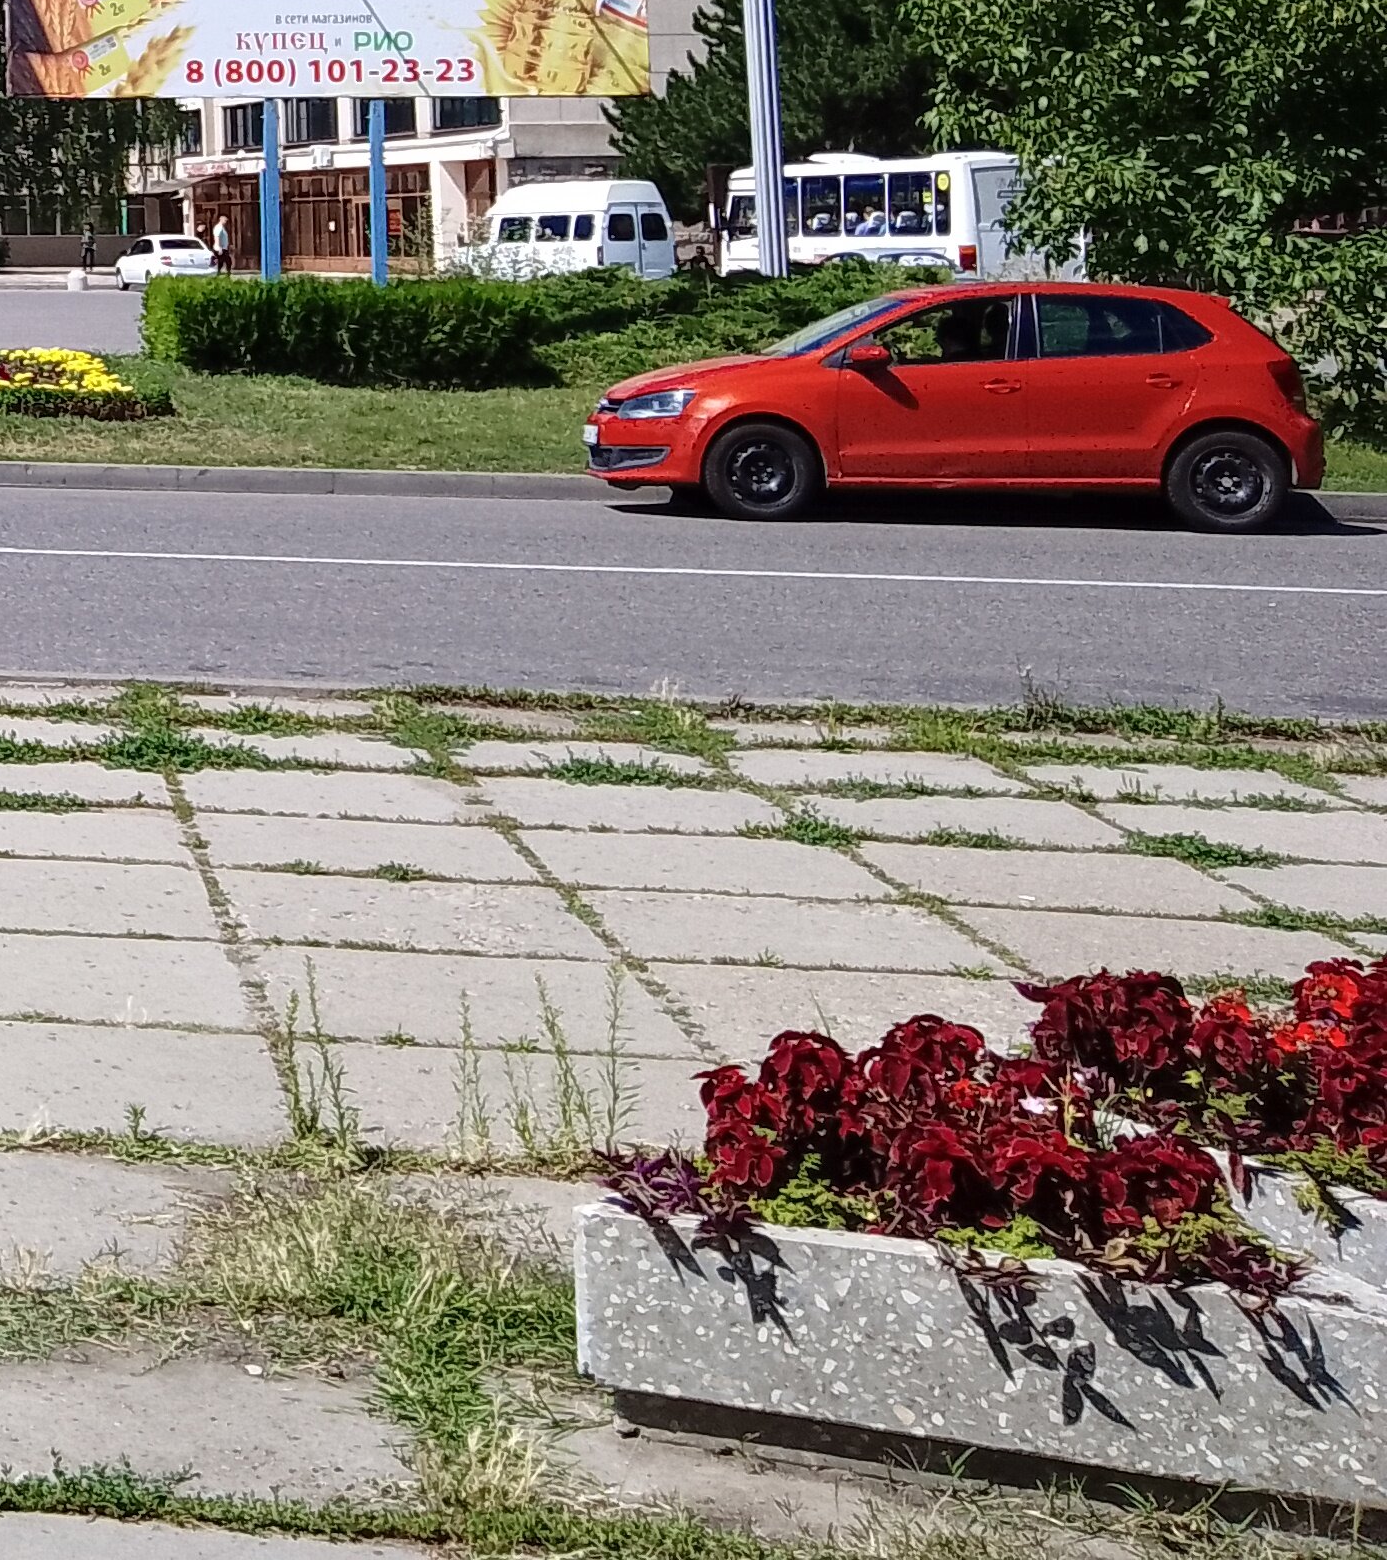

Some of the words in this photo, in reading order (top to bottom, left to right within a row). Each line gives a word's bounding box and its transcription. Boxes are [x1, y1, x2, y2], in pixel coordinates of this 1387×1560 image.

[284, 14, 309, 25] сети
[312, 14, 373, 25] магазинов
[353, 31, 414, 52] РИО
[185, 59, 204, 83] 8
[214, 58, 297, 87] (800)
[308, 58, 475, 83] 101-23-23
